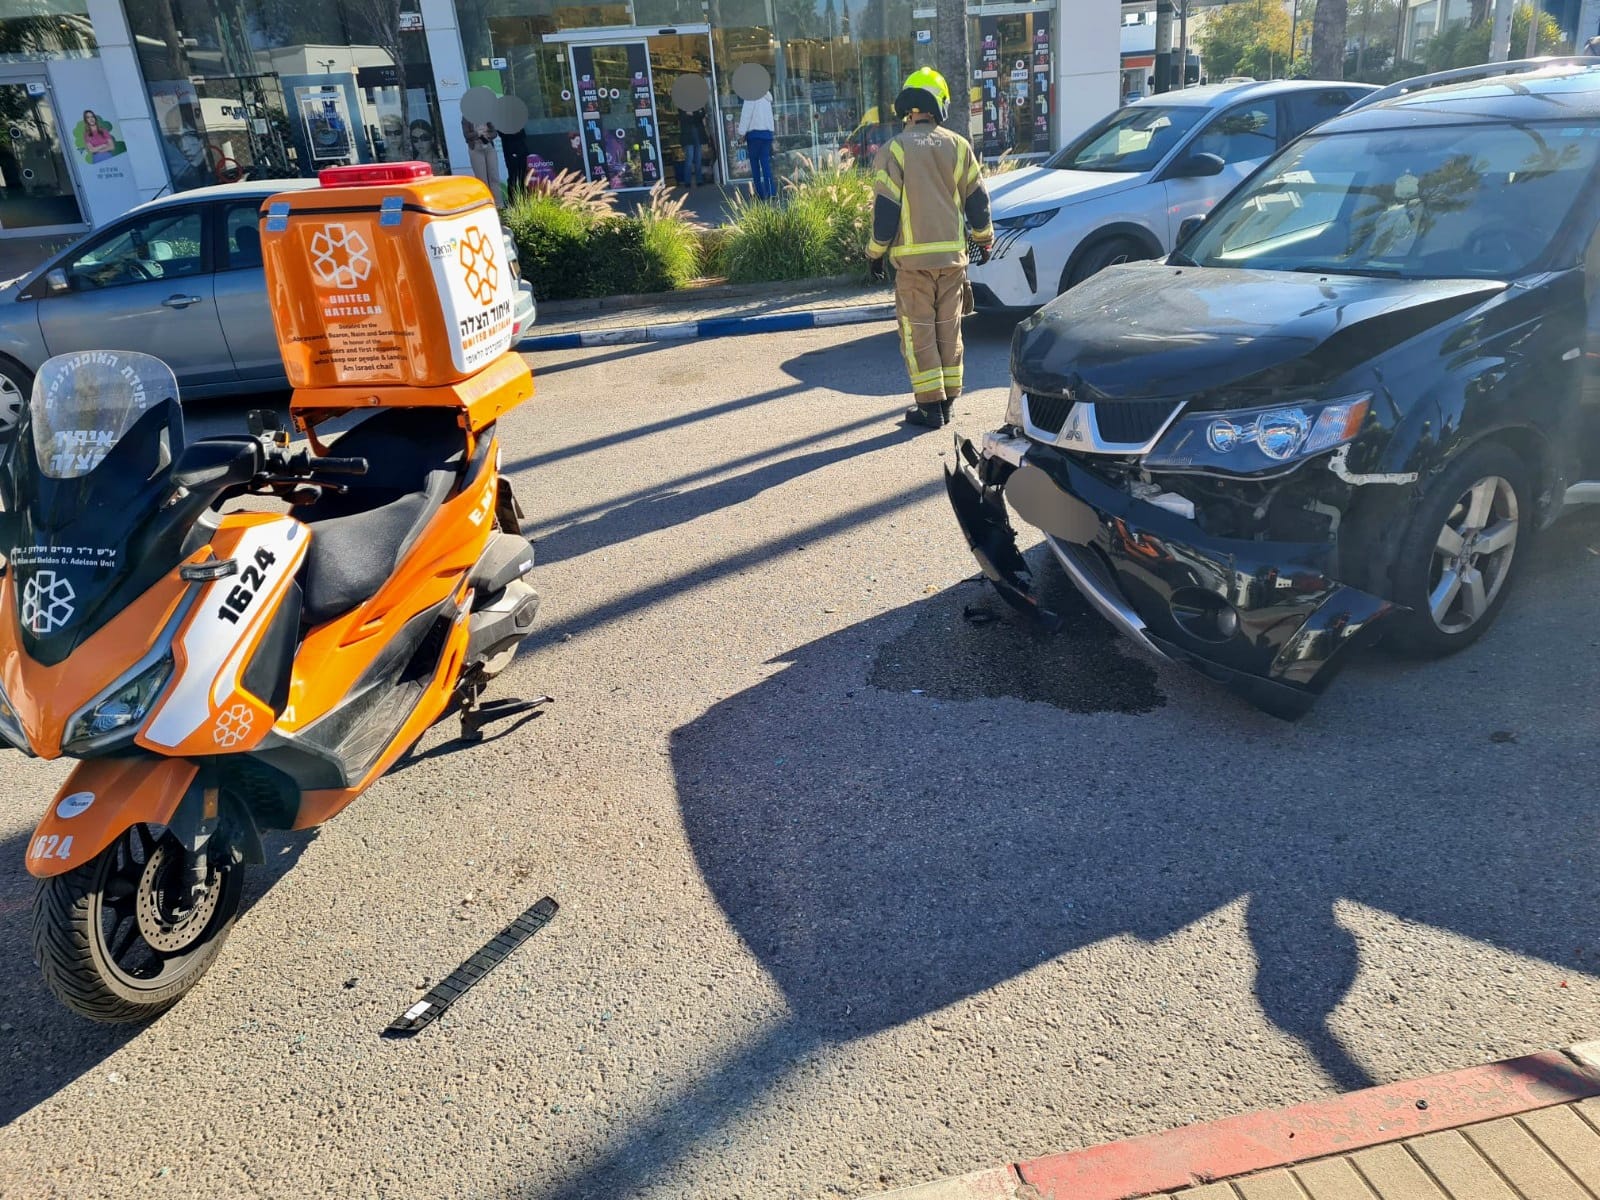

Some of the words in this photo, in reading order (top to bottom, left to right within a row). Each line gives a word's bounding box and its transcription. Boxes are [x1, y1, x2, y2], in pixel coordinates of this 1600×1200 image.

[430, 244, 451, 256] הראל
[329, 293, 370, 304] UNITED
[324, 305, 382, 317] HATZALAH
[490, 298, 510, 322] איחוד
[460, 311, 489, 336] הצלה
[462, 330, 487, 349] UNITED
[120, 365, 146, 409] יחידת
[54, 430, 114, 446] איחוד
[50, 546, 73, 554] מרים
[70, 558, 98, 567] Adelson
[100, 559, 115, 568] Unit
[218, 547, 276, 625] 1624
